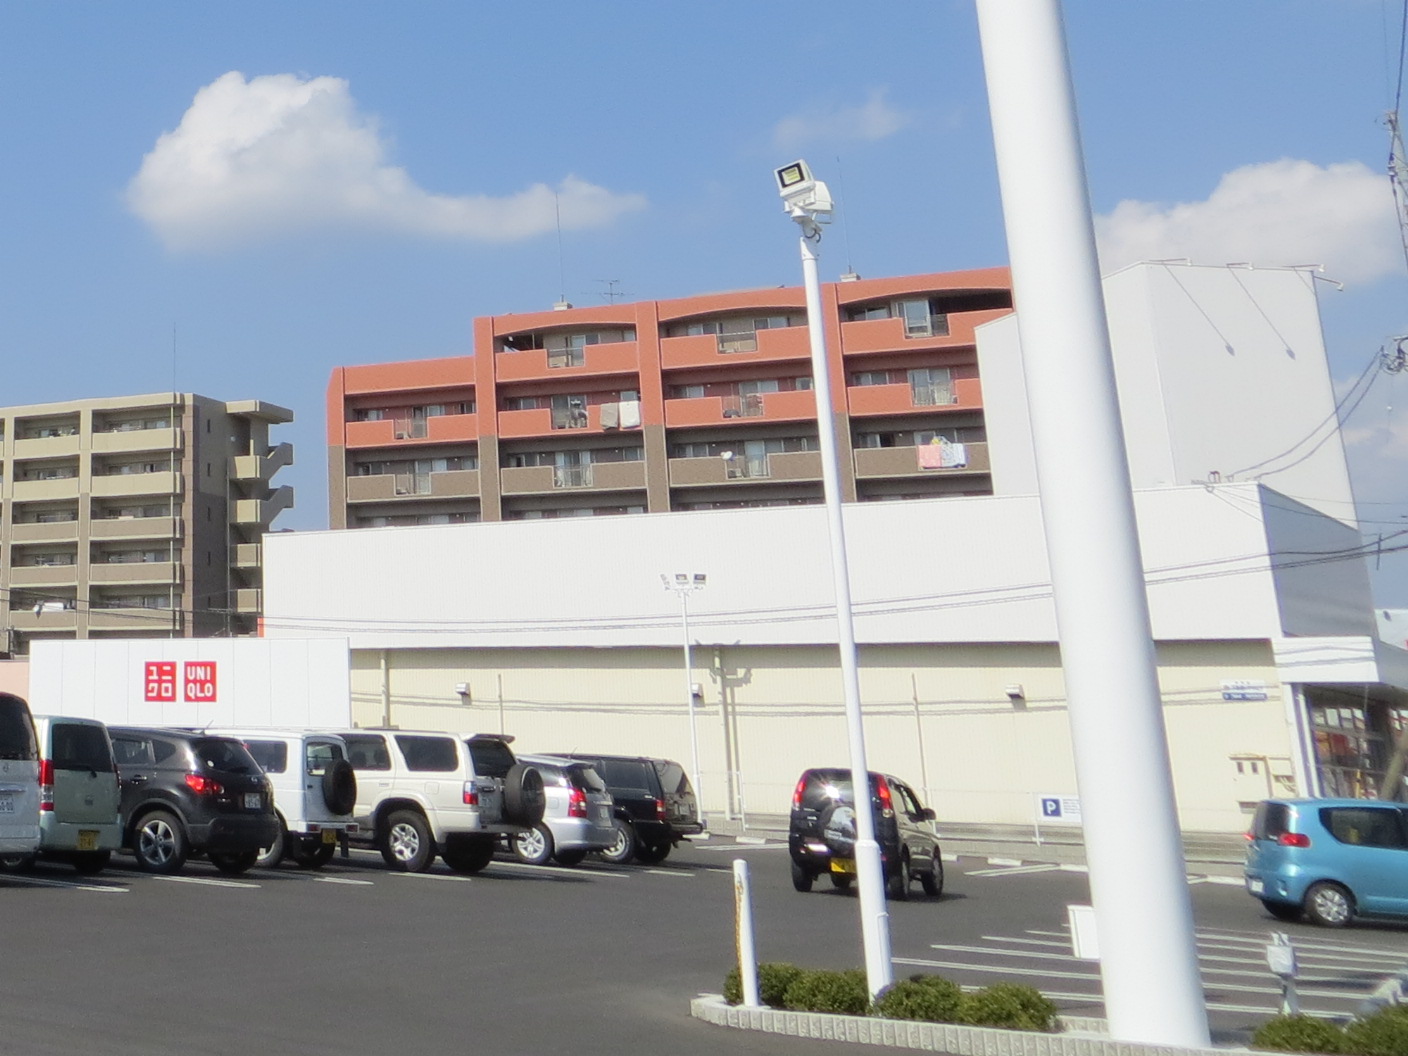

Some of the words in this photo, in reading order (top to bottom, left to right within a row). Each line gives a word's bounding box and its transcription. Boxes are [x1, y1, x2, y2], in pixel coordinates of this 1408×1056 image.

[148, 665, 172, 680] ユニ
[186, 665, 211, 680] UNI
[147, 682, 173, 697] クロ
[186, 682, 213, 699] QLO
[1046, 800, 1057, 815] P
